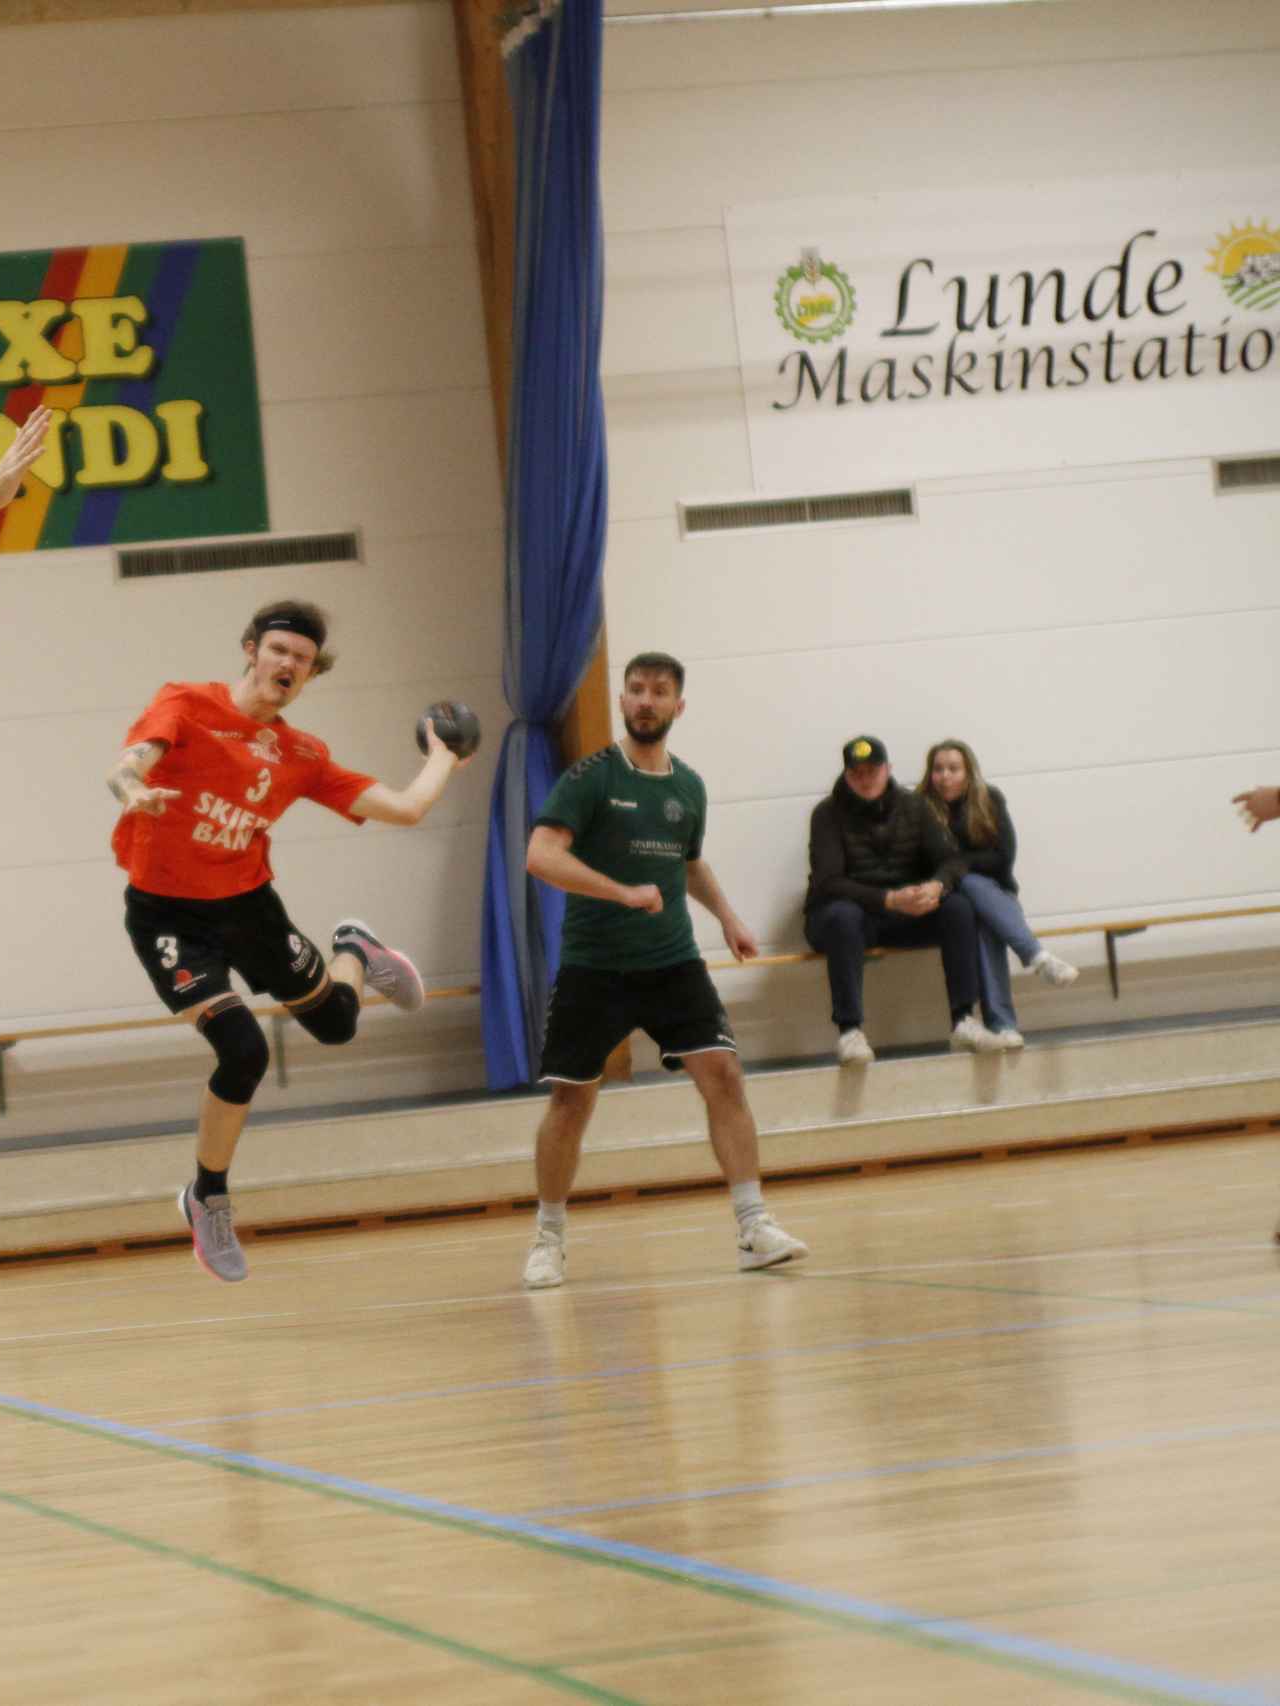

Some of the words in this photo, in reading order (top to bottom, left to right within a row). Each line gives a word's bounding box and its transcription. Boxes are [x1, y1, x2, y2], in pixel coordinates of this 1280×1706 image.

[879, 229, 1188, 338] Lunde
[771, 316, 1280, 410] Maskinstatio
[245, 767, 272, 803] 3
[155, 935, 179, 969] 3
